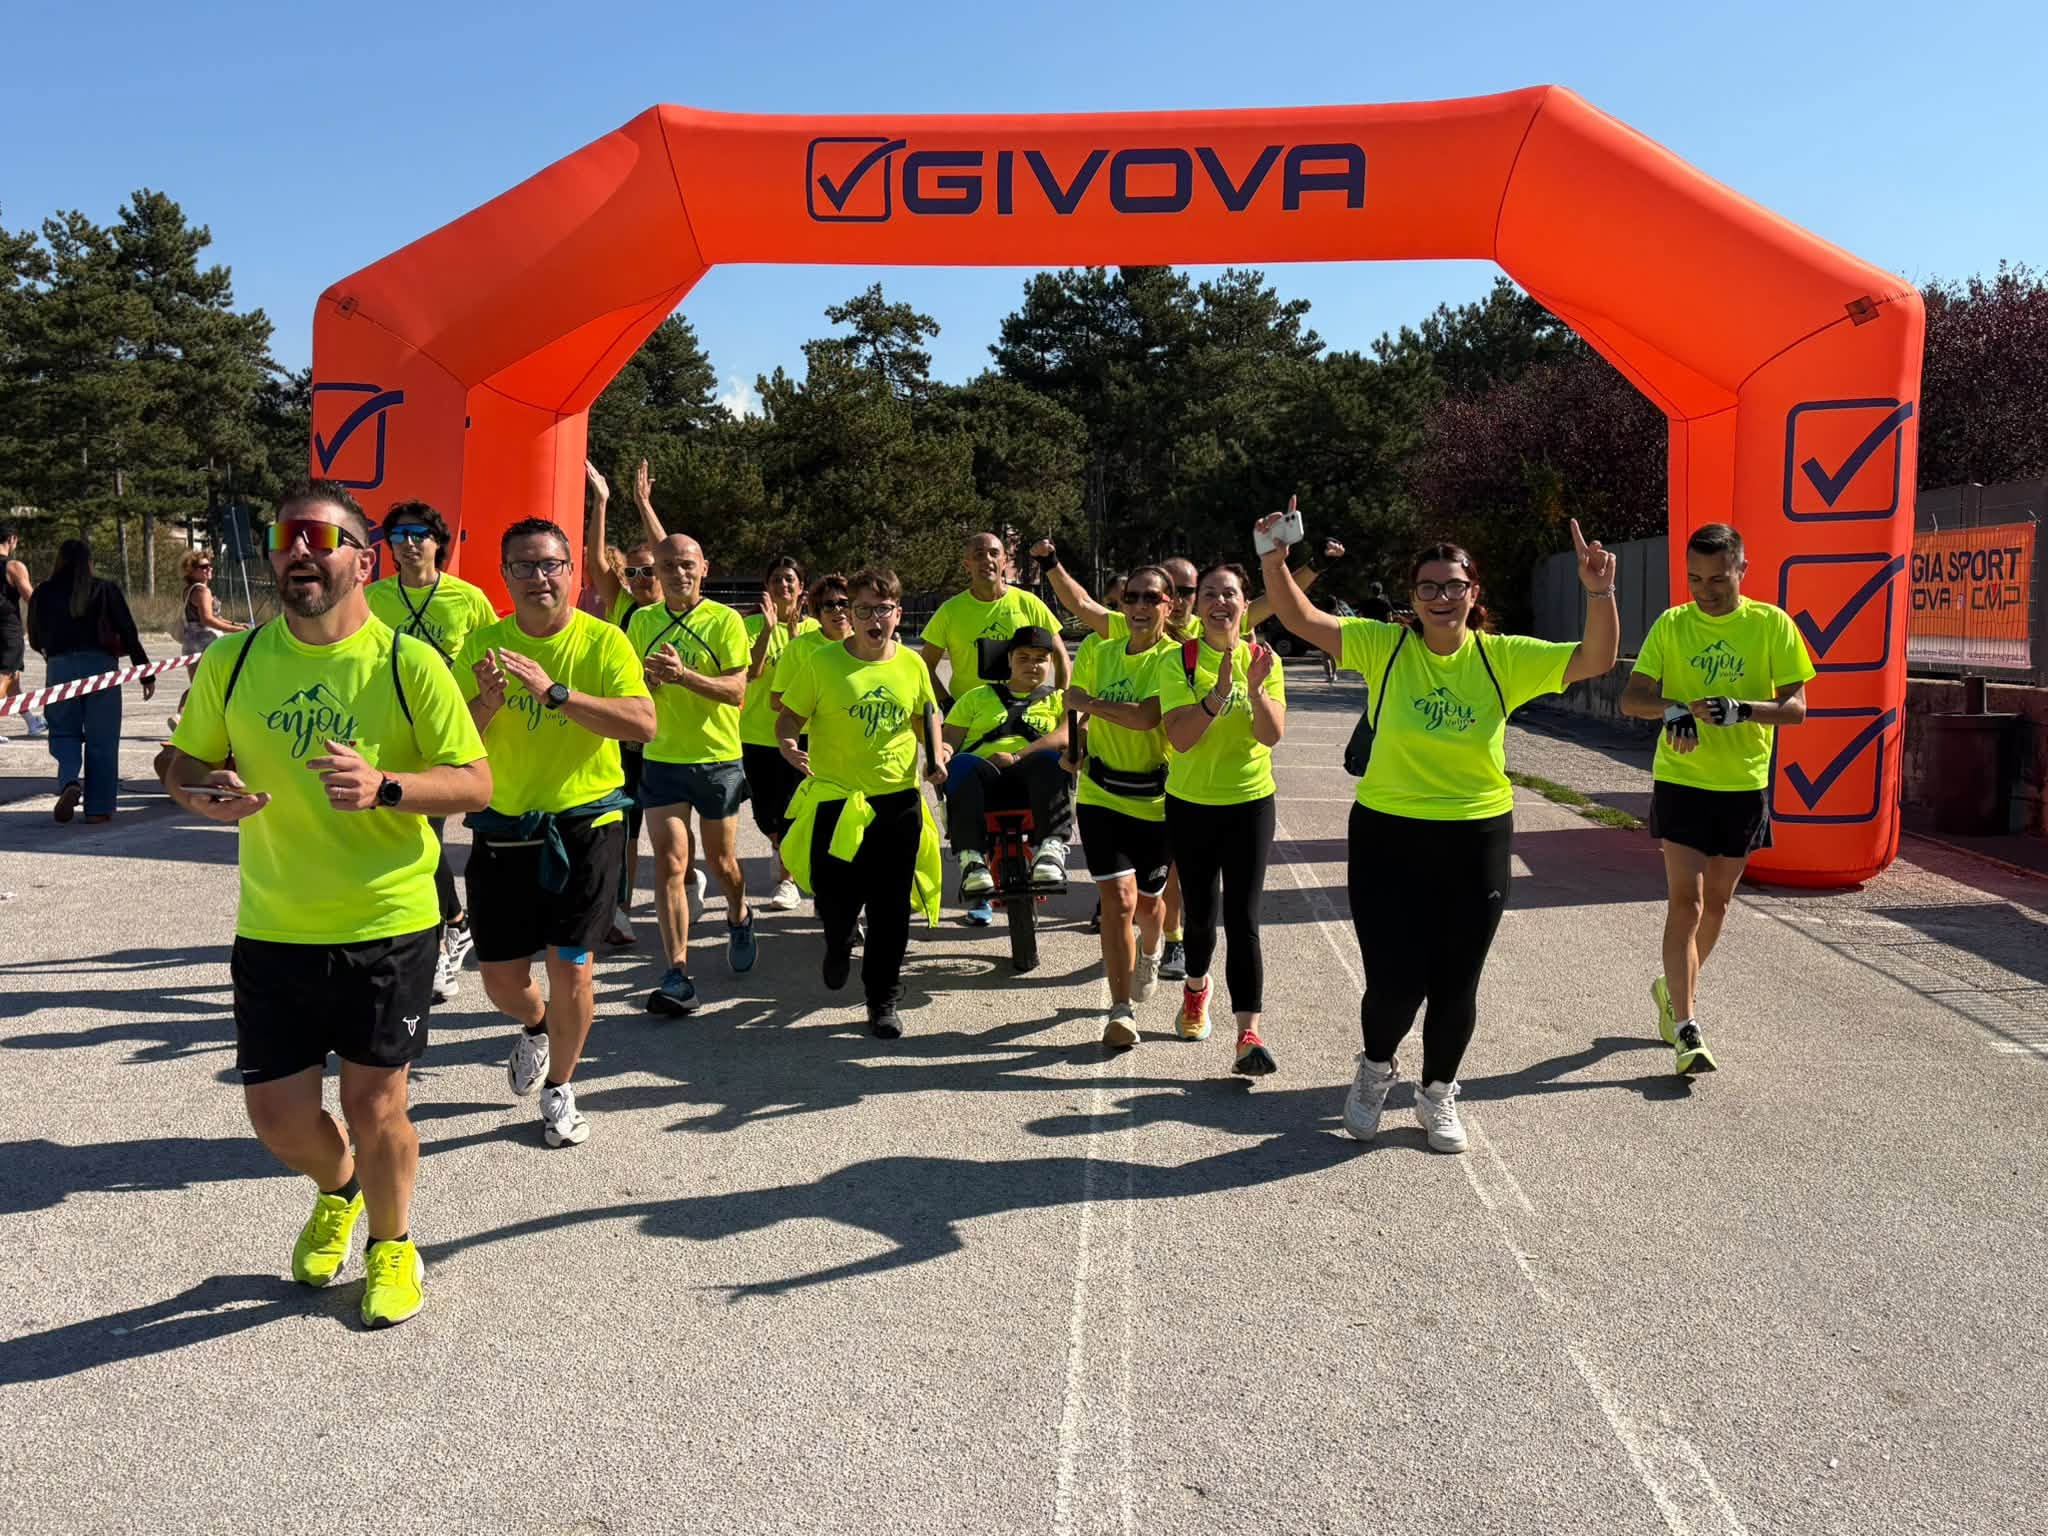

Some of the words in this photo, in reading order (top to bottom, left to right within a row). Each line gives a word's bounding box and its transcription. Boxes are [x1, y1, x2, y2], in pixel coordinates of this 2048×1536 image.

[902, 143, 1366, 215] GIVOVA
[1947, 547, 2022, 582] SPORT
[1971, 584, 2020, 611] CMP
[1688, 653, 1745, 686] enjoy
[841, 701, 906, 738] enjoy
[1411, 696, 1473, 732] enjoy
[257, 706, 360, 760] enjoy
